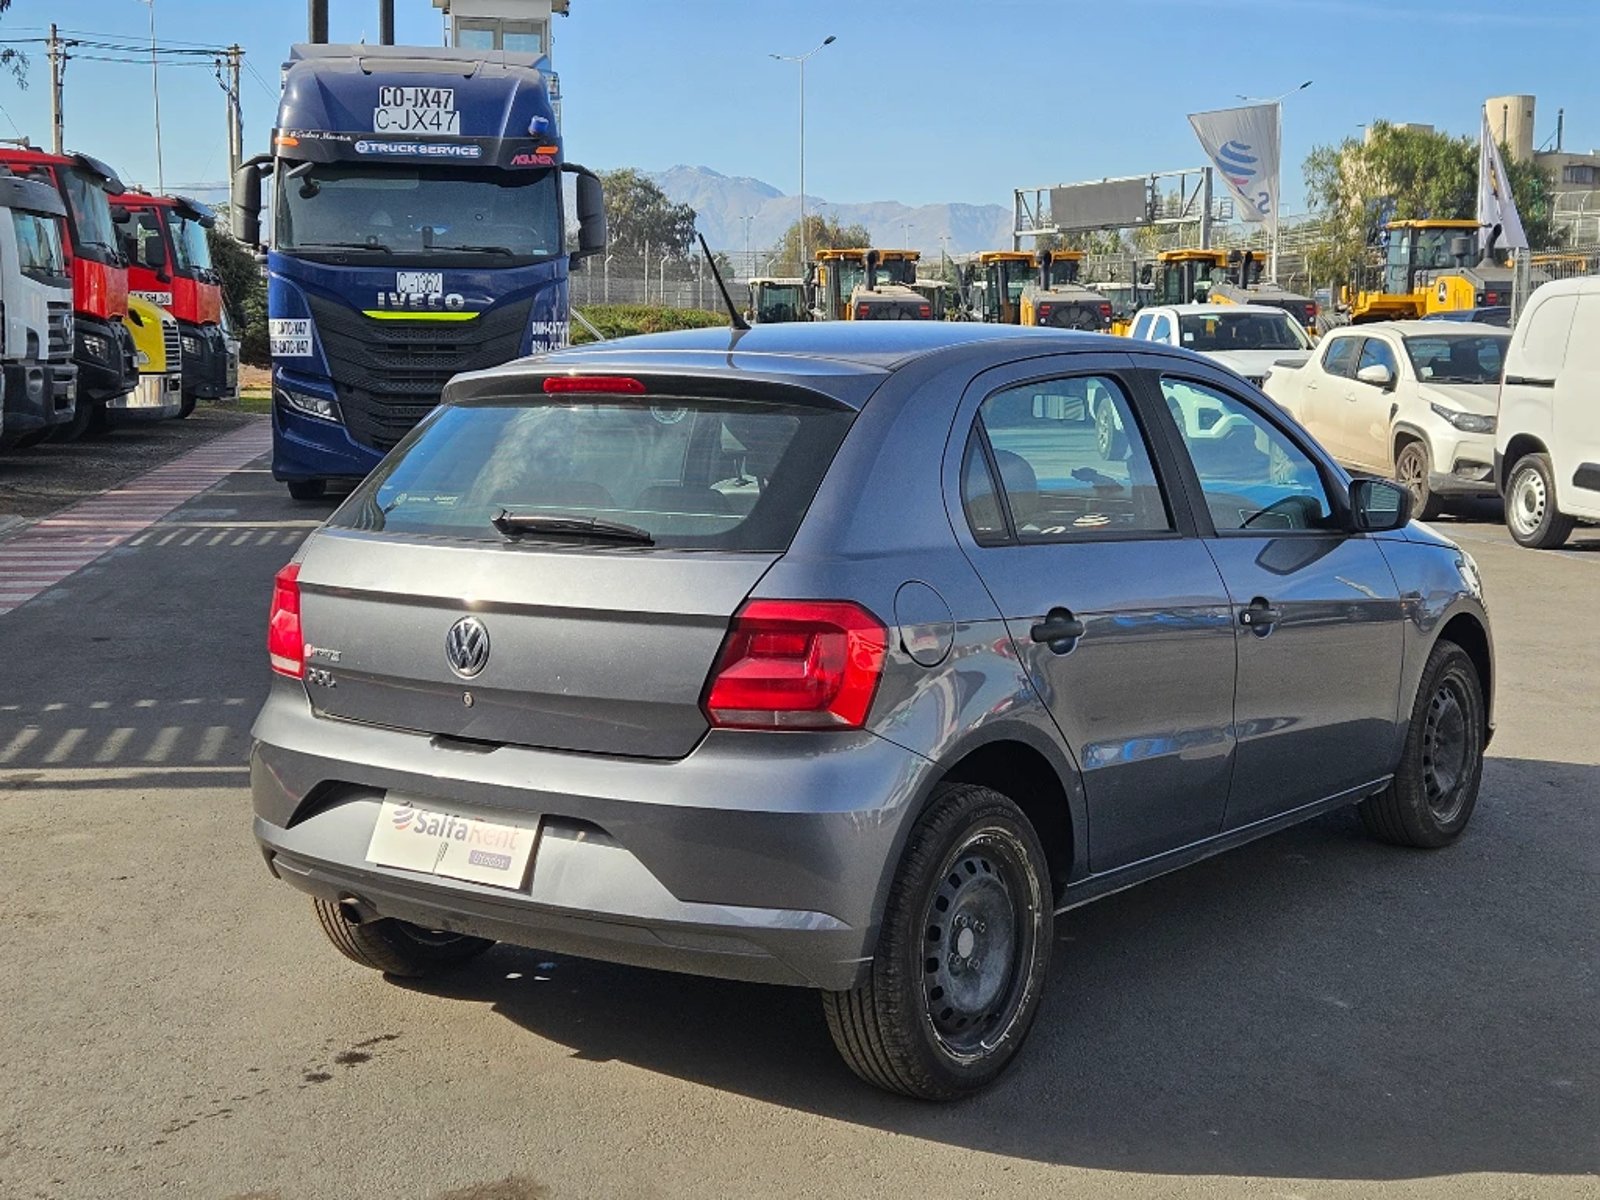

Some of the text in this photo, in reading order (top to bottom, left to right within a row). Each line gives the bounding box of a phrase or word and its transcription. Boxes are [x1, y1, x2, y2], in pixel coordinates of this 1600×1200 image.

[369, 143, 479, 156] TRUCK SERVICE
[377, 292, 465, 310] IVECO
